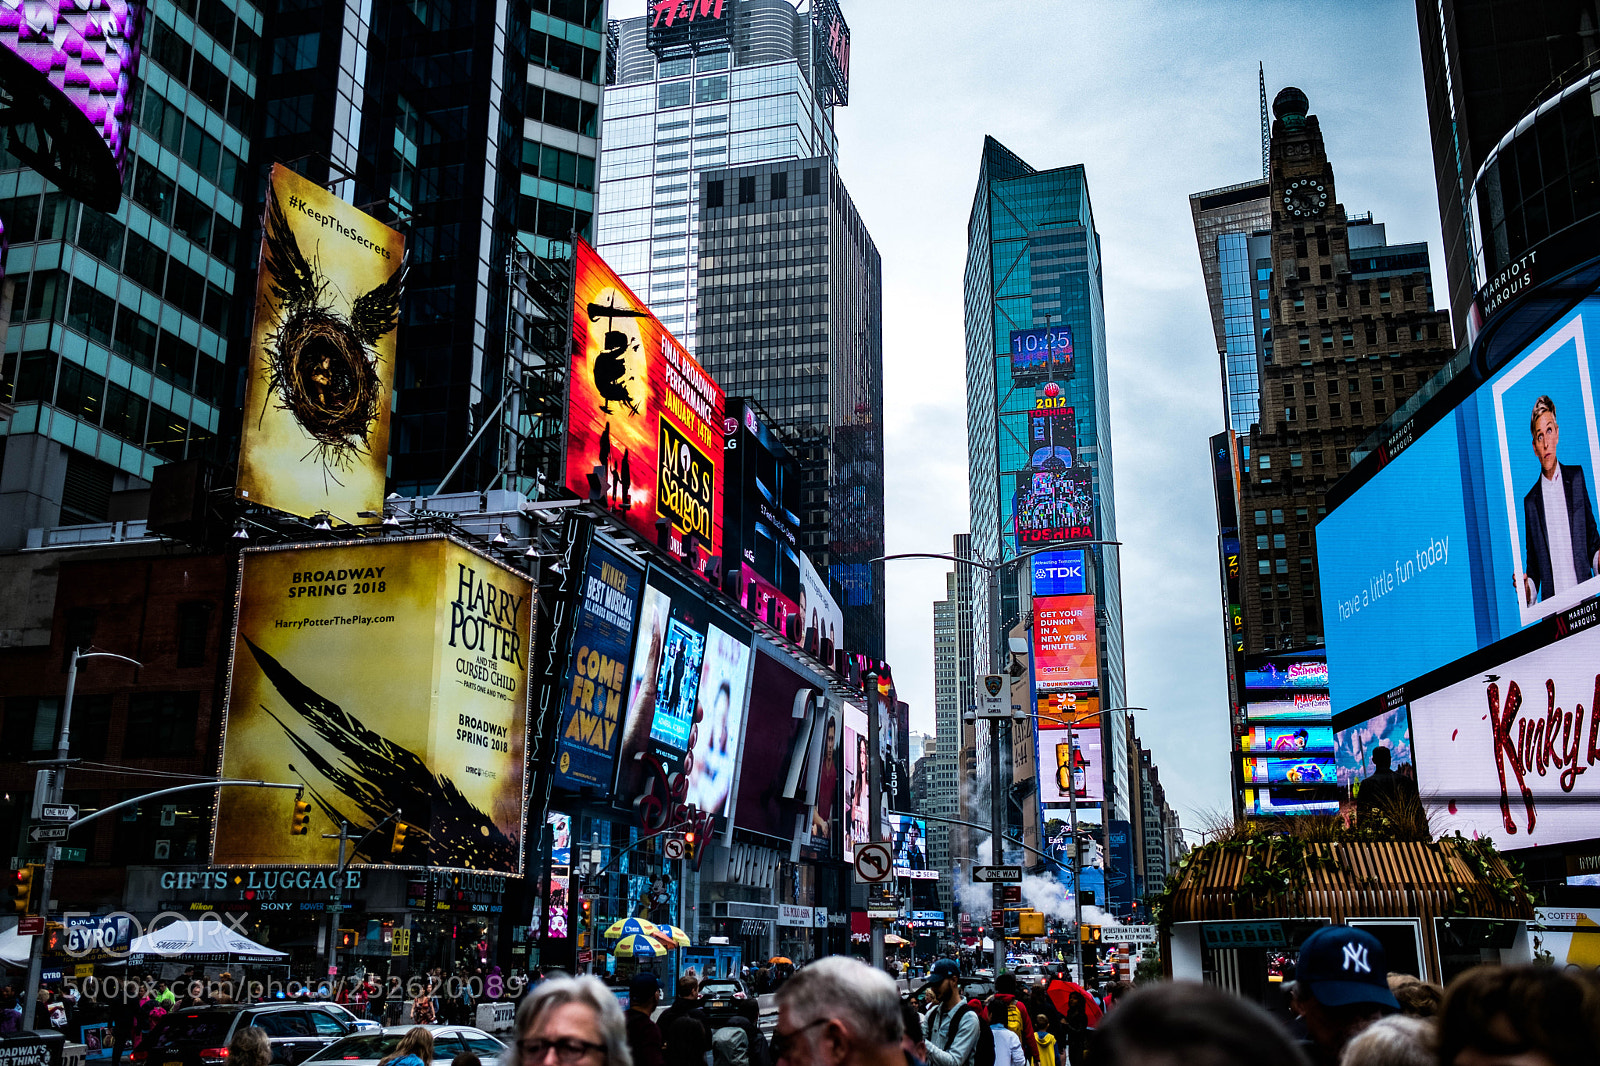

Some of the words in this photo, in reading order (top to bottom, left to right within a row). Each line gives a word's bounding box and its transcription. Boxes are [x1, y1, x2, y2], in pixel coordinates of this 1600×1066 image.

[288, 195, 391, 260] #KeepTheSecrets
[1482, 250, 1537, 301] MARRIOTT
[1484, 272, 1531, 317] MARQUIS
[1013, 331, 1070, 352] 10:25
[661, 333, 681, 371] FINAL
[682, 356, 717, 407] BROADWAY
[665, 363, 712, 426] PERFORMANCE
[1036, 397, 1067, 409] 2017
[663, 387, 695, 432] JANUARY
[697, 418, 712, 449] 14TH
[1029, 407, 1074, 418] TOSHIBA
[1388, 418, 1414, 447] MARRIOTT
[723, 438, 737, 450] G
[1389, 433, 1412, 458] MARQUIS
[661, 466, 711, 540] Saigon
[413, 508, 455, 519] LAMAR
[1019, 525, 1093, 541] TOSHIBA
[292, 566, 386, 584] BROADWAY
[1045, 566, 1082, 579] TDK
[1338, 595, 1361, 622] have
[1363, 588, 1369, 608] a
[1370, 568, 1394, 603] little
[1395, 557, 1415, 587] fun
[1415, 535, 1450, 572] today
[288, 584, 347, 599] SPRING
[352, 581, 386, 595] 2018
[455, 563, 524, 632] HARRY
[587, 576, 606, 605] BEST
[605, 584, 633, 621] MUSICAL
[584, 599, 592, 612] ALL
[1568, 601, 1598, 621] MARRIOTT
[275, 614, 395, 629] HarryPotterThePlay.com
[1041, 618, 1076, 627] DUNKIN'
[1570, 613, 1597, 630] MARQUIS
[448, 601, 525, 671] POTTER
[1041, 635, 1061, 643] NEW
[1041, 643, 1076, 651] MINUTE.
[475, 656, 487, 666] AND
[487, 659, 498, 670] THE
[577, 645, 625, 692] COME
[455, 657, 489, 683] CURSED
[490, 671, 516, 692] CHILD
[463, 680, 476, 692] PARTS
[476, 684, 486, 695] ONE
[486, 687, 496, 697] AND
[496, 690, 507, 701] TWO
[570, 675, 622, 722] FROM
[458, 713, 508, 738] BROADWAY
[564, 708, 617, 751] AWAY
[456, 728, 489, 750] SPRING
[491, 737, 508, 753] 2018
[1486, 678, 1587, 835] Kinky
[46, 808, 56, 816] ONE
[58, 808, 69, 816] WAY
[39, 829, 51, 837] ONE
[52, 829, 65, 837] WAY
[160, 871, 228, 890] GIFTS
[247, 871, 361, 890] LUGGAGE
[460, 872, 507, 893] LUGGAGE
[987, 870, 1002, 878] ONE
[1003, 870, 1017, 878] WAY
[255, 890, 276, 900] NY
[190, 902, 214, 910] Nikon
[300, 902, 325, 911] BOWER
[472, 904, 489, 912] SONY
[1547, 912, 1587, 920] COFFEED
[67, 927, 117, 951] GYRO
[393, 930, 401, 952] ATM
[1341, 941, 1372, 973] NY
[42, 971, 61, 979] GYRO
[12, 1056, 41, 1066] THING
